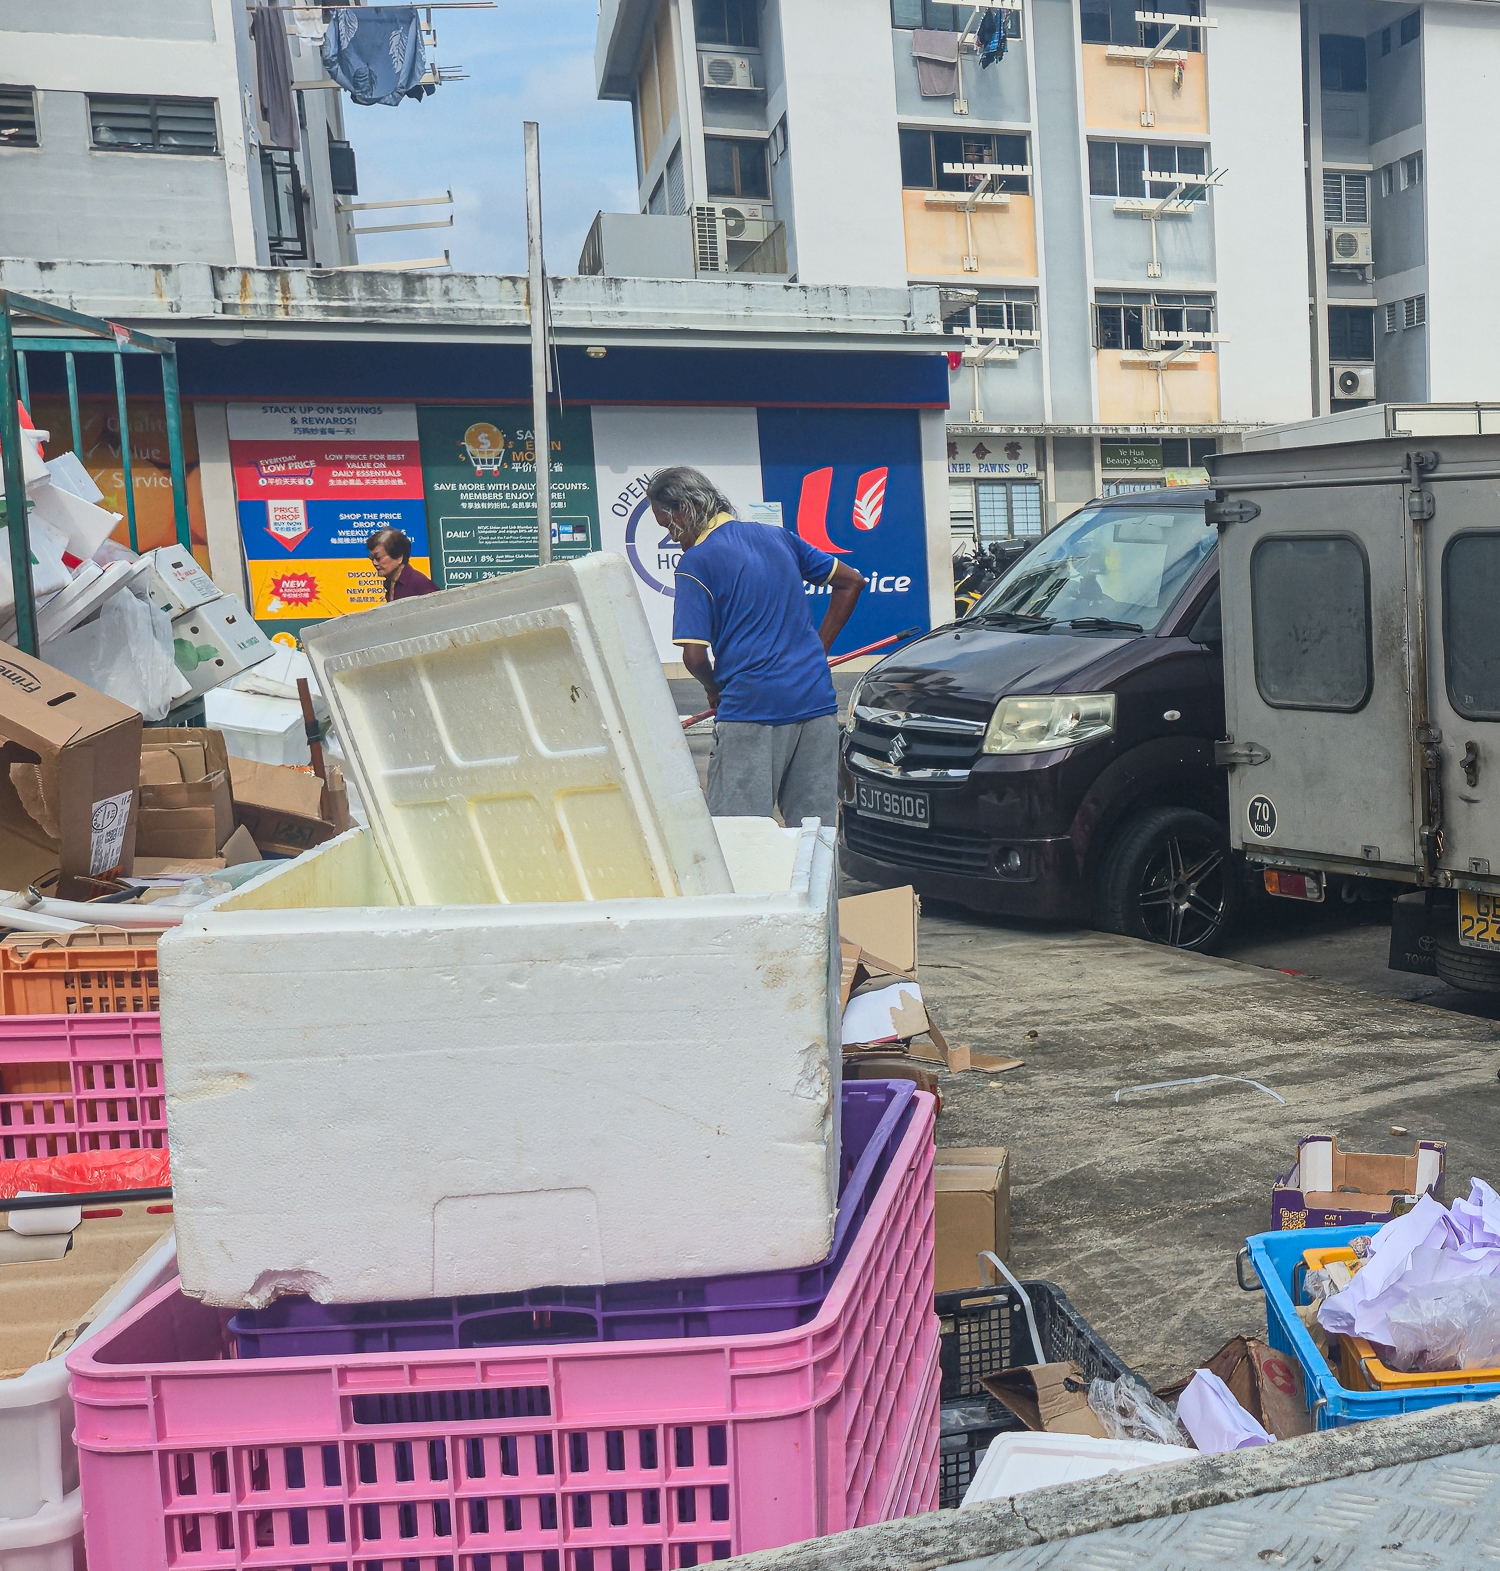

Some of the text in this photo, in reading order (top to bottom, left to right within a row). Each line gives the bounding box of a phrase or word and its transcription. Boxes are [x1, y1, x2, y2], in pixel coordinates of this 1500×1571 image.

[261, 406, 383, 415] STACK UP ON SAVINGS
[290, 417, 357, 425] & REWARDS!
[516, 429, 537, 440] SA
[525, 440, 562, 451] EN
[107, 443, 161, 460] Vlue
[260, 455, 297, 466] EVERYDAY
[1106, 457, 1132, 466] Beauty
[1133, 457, 1158, 465] Saloon
[263, 459, 317, 474] LOW PRICE
[948, 463, 1029, 473] NHE PAWNS OP
[112, 472, 173, 489] Srvic
[434, 483, 457, 491] SAVE
[459, 483, 486, 491] MORE
[551, 482, 590, 490] COUNTS.
[460, 491, 566, 500] MEMBERS ENJOY RE!
[611, 473, 651, 518] OPEN
[273, 506, 299, 514] PRICE
[448, 555, 473, 563] DAILY
[480, 555, 494, 563] 8%
[449, 572, 472, 580] MON
[281, 580, 308, 588] NEW
[1254, 801, 1270, 822] 70
[1254, 821, 1271, 833] km/h
[1405, 952, 1436, 966] TOYO
